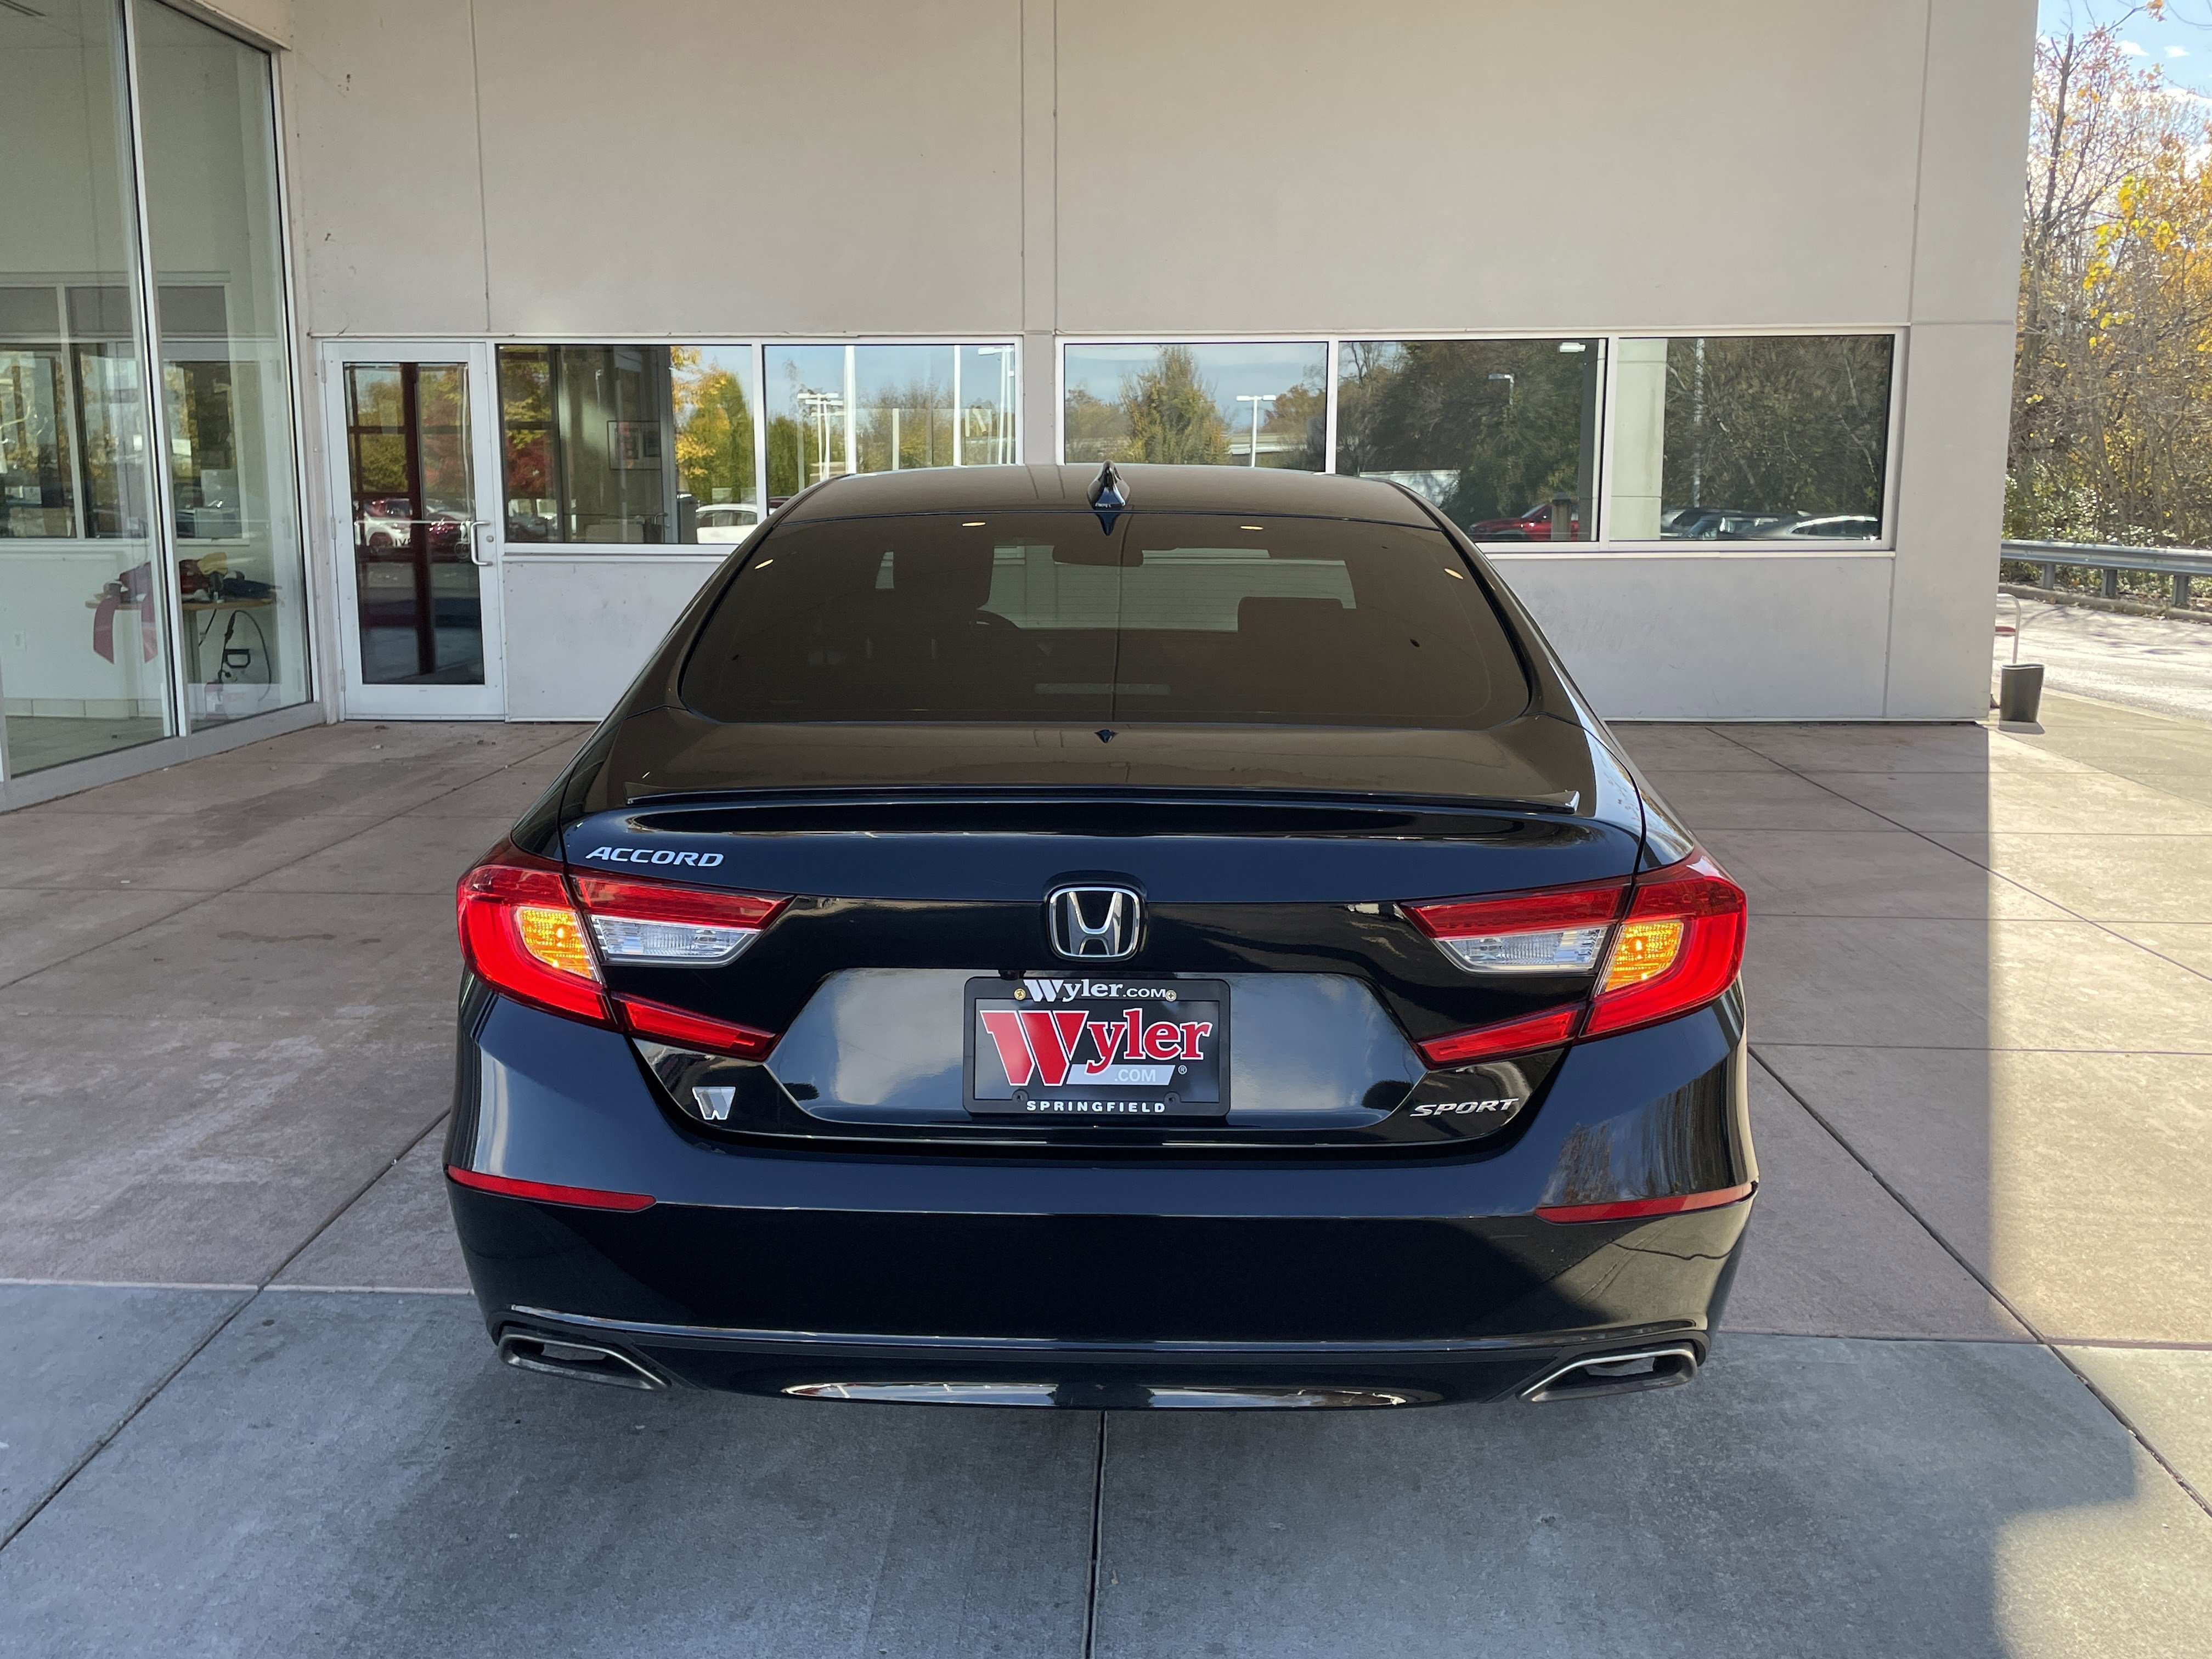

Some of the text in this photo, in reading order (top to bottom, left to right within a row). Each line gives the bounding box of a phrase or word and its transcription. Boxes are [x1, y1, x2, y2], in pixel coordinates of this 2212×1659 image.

[585, 846, 724, 867] ACCORD
[979, 1008, 1212, 1087] Wyler
[1114, 1069, 1156, 1082] .COM
[1026, 1100, 1166, 1113] SPRINGFIELD
[1409, 1098, 1520, 1117] SPORT
